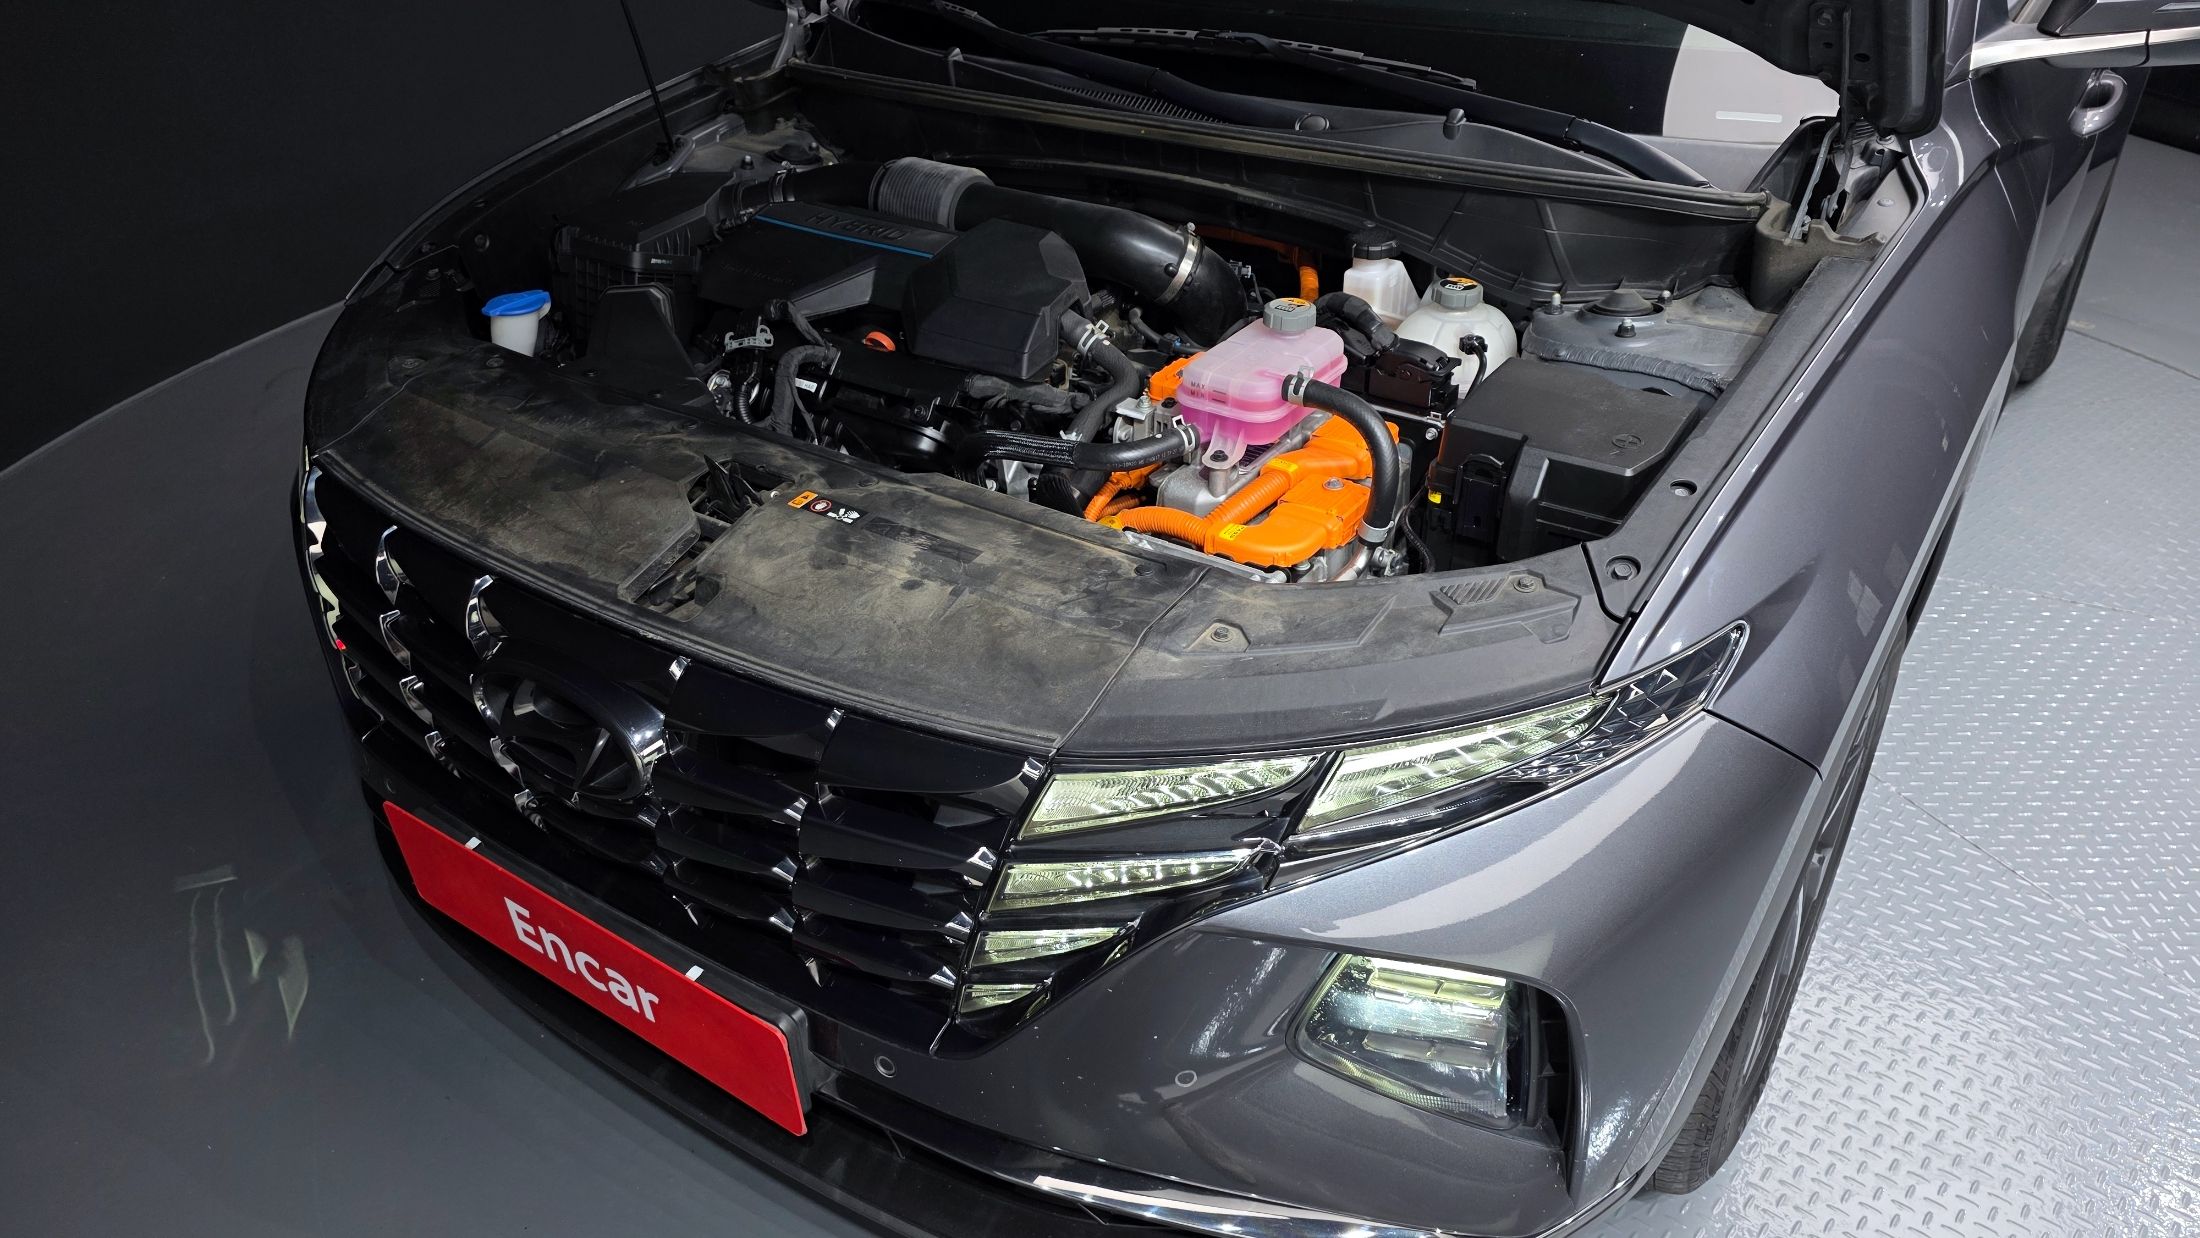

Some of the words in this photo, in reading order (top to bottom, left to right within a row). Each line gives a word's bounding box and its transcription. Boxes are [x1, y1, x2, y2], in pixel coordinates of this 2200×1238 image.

[807, 212, 909, 240] HYBRID
[1190, 381, 1206, 390] MAX
[1190, 389, 1205, 398] MIN
[503, 896, 659, 1023] Encar
